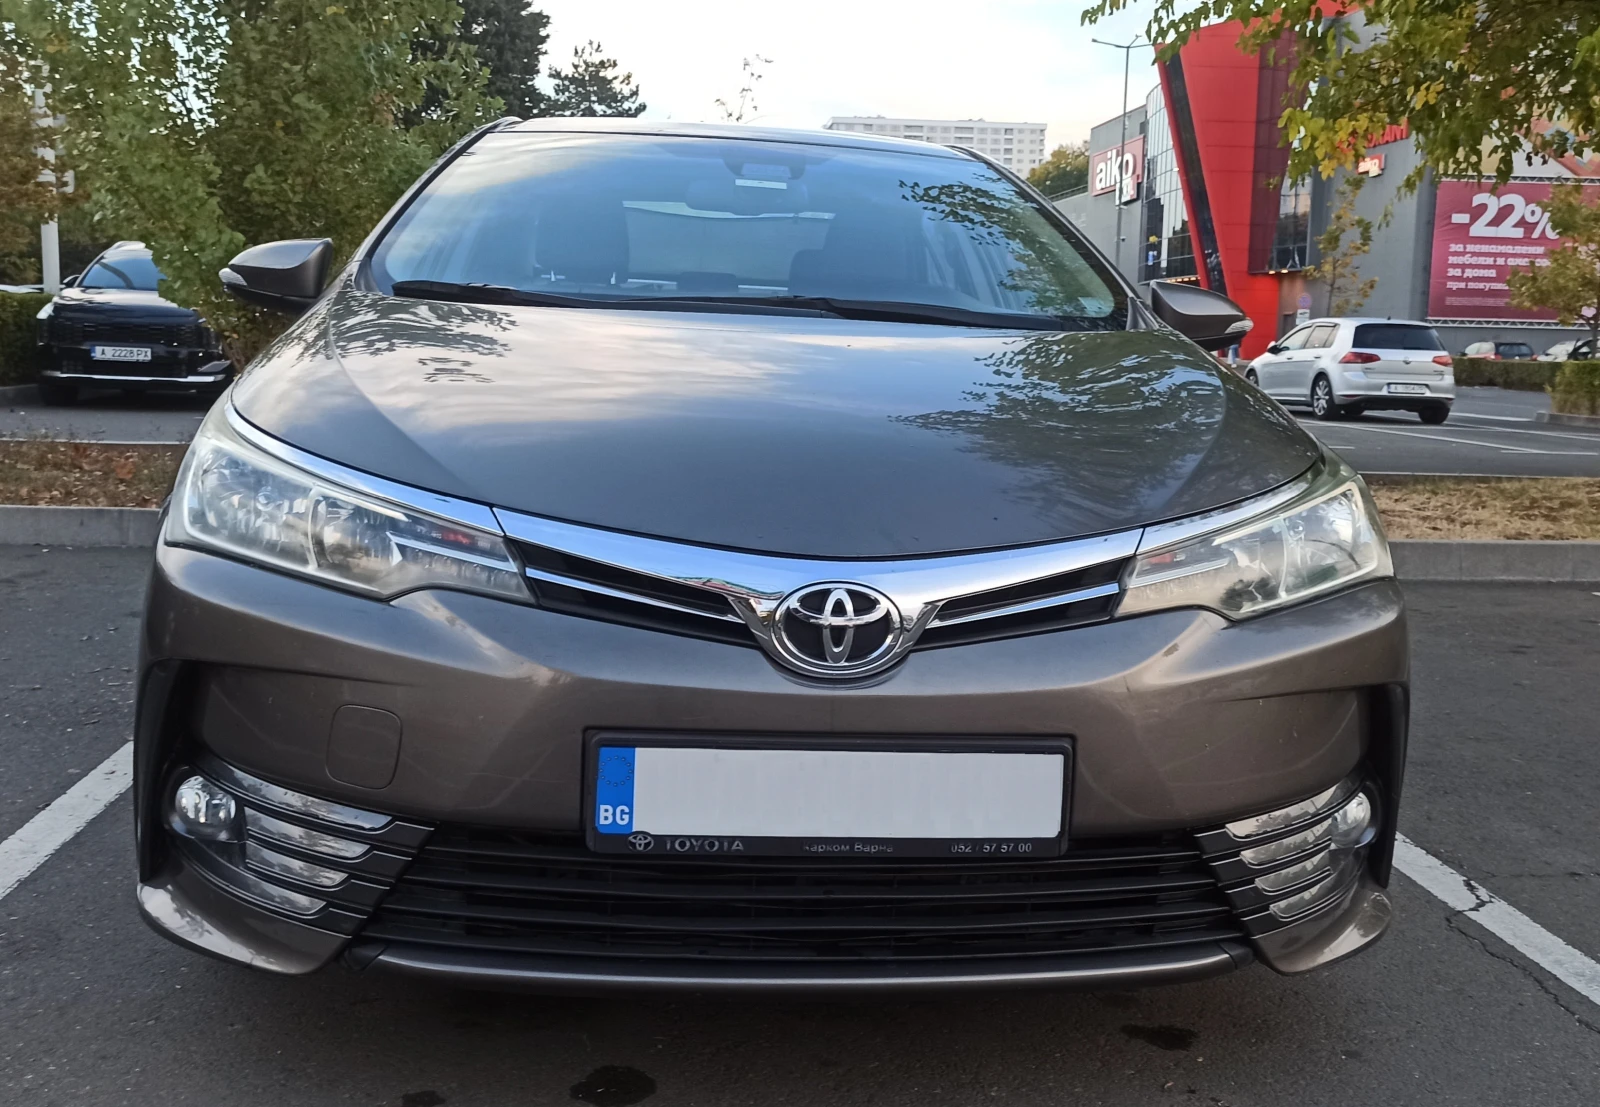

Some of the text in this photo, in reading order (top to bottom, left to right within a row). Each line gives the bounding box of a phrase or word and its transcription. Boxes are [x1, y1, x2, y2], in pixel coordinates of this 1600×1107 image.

[1096, 149, 1134, 190] aiko
[1451, 193, 1560, 240] -22%
[1449, 244, 1464, 252] за
[1448, 254, 1494, 265] мебели
[1496, 257, 1505, 265] и
[1447, 268, 1497, 278] за дома
[599, 804, 630, 825] BG
[664, 837, 744, 852] TOYOTA
[854, 841, 894, 854] Варна
[951, 842, 972, 853] 052
[983, 842, 997, 853] 57
[1000, 842, 1015, 853] 57
[1018, 842, 1032, 853] 00
